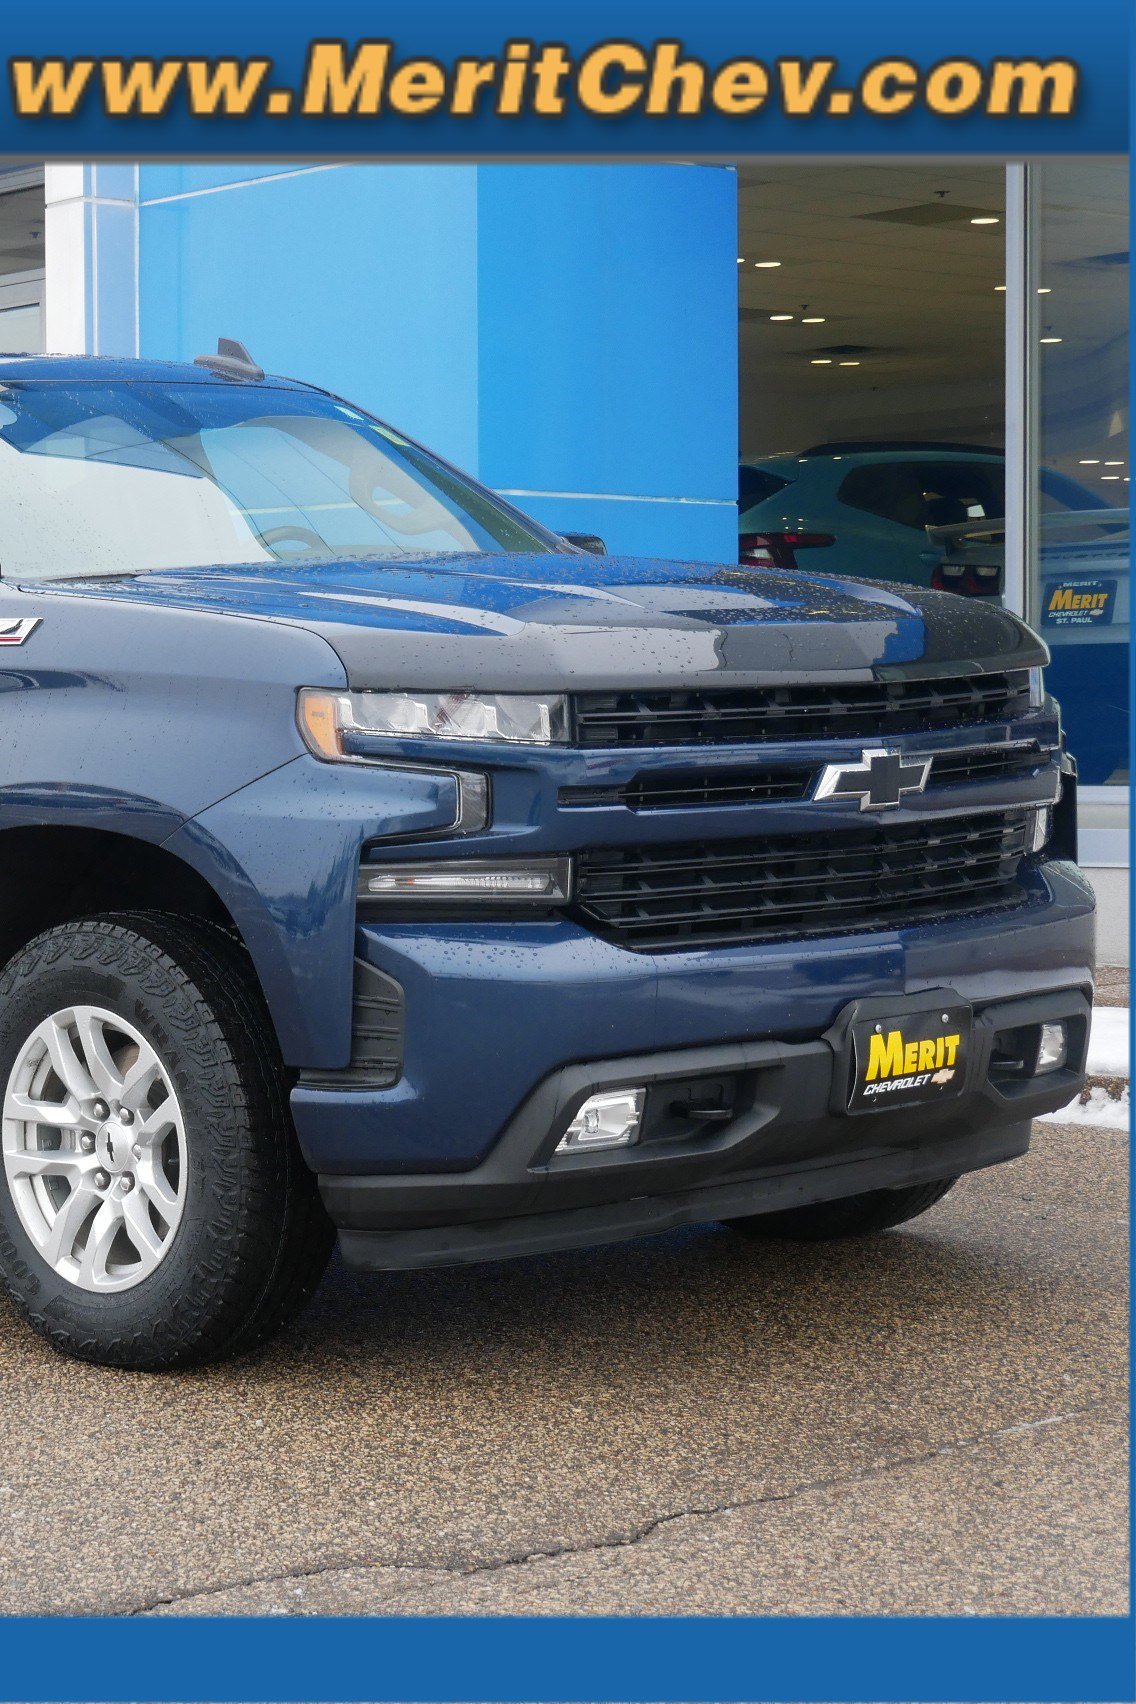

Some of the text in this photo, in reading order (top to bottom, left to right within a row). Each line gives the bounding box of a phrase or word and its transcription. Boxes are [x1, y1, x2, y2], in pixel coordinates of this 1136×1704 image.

[1048, 589, 1108, 610] MERIT
[1048, 610, 1088, 618] CHEVROLET
[865, 1031, 960, 1081] MERIT
[863, 1074, 931, 1096] CHEVROLET
